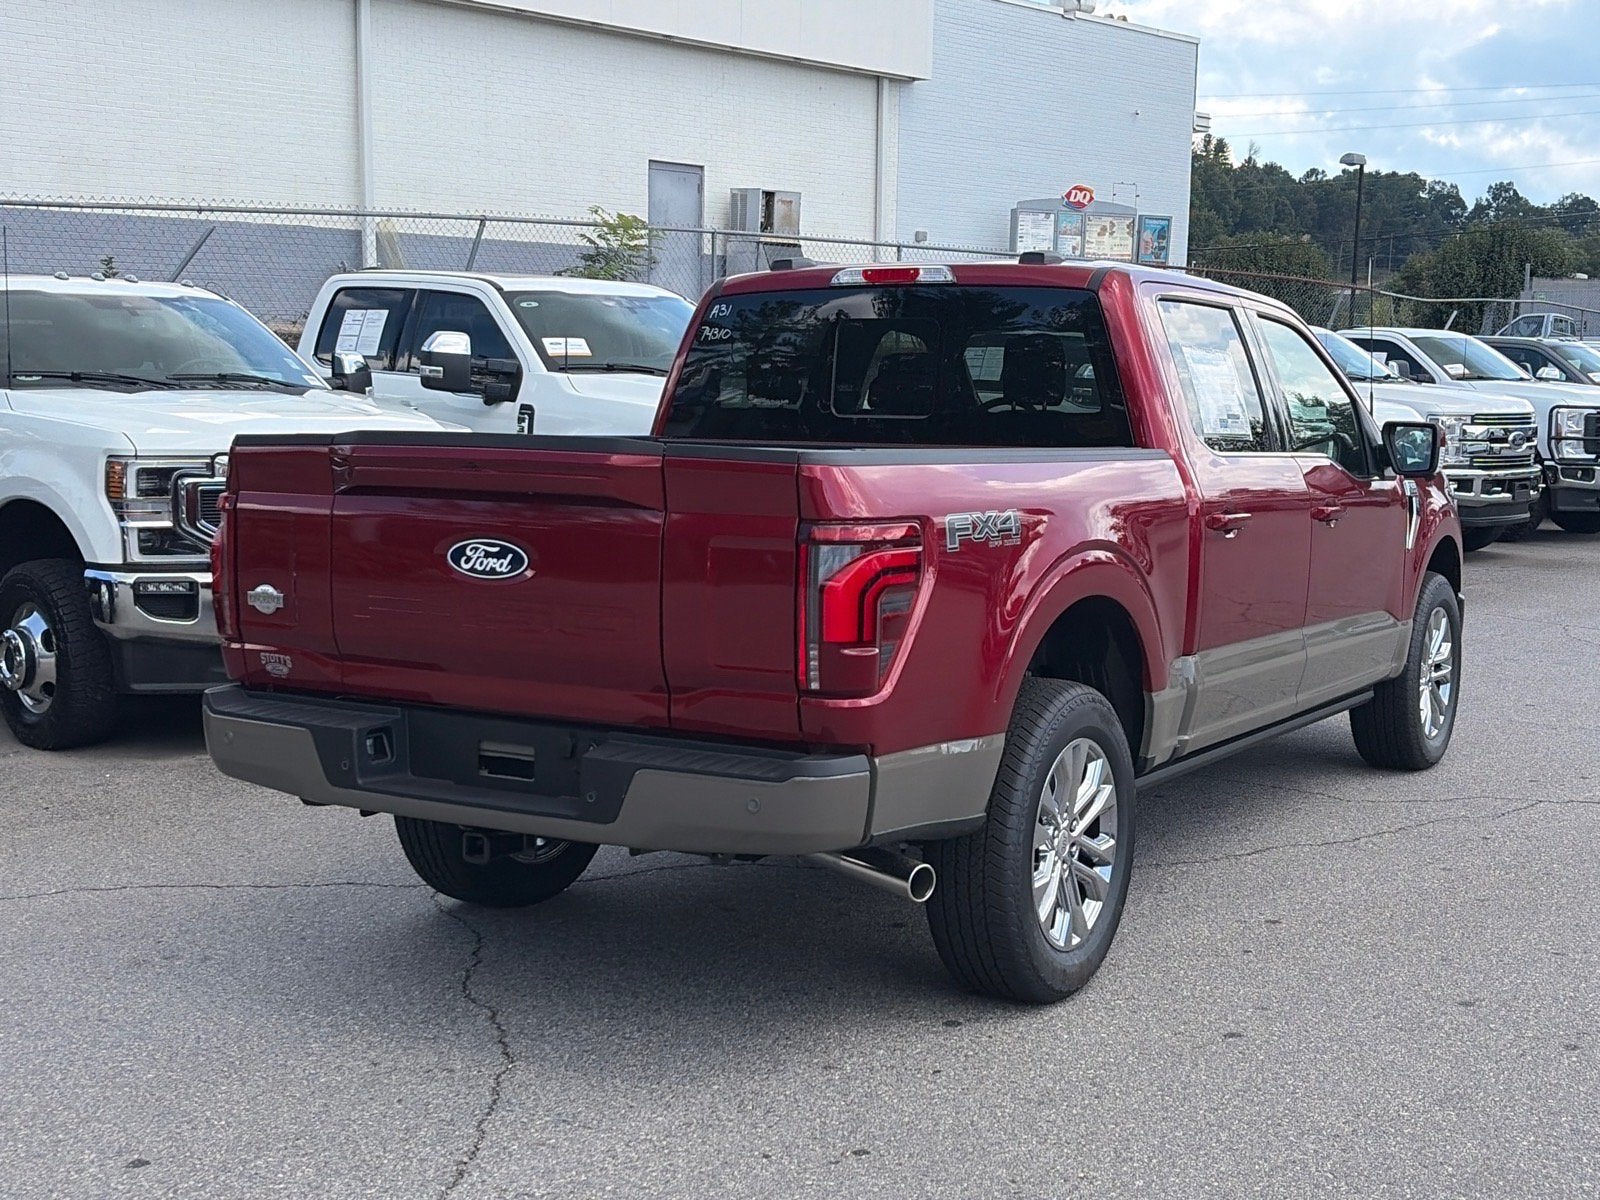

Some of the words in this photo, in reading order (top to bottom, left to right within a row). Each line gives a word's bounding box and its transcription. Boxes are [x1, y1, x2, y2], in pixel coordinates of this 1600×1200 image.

[1069, 190, 1091, 204] DQ
[709, 303, 732, 319] A31
[700, 325, 732, 341] 74310
[945, 508, 1021, 553] FX4
[460, 543, 514, 573] Ford
